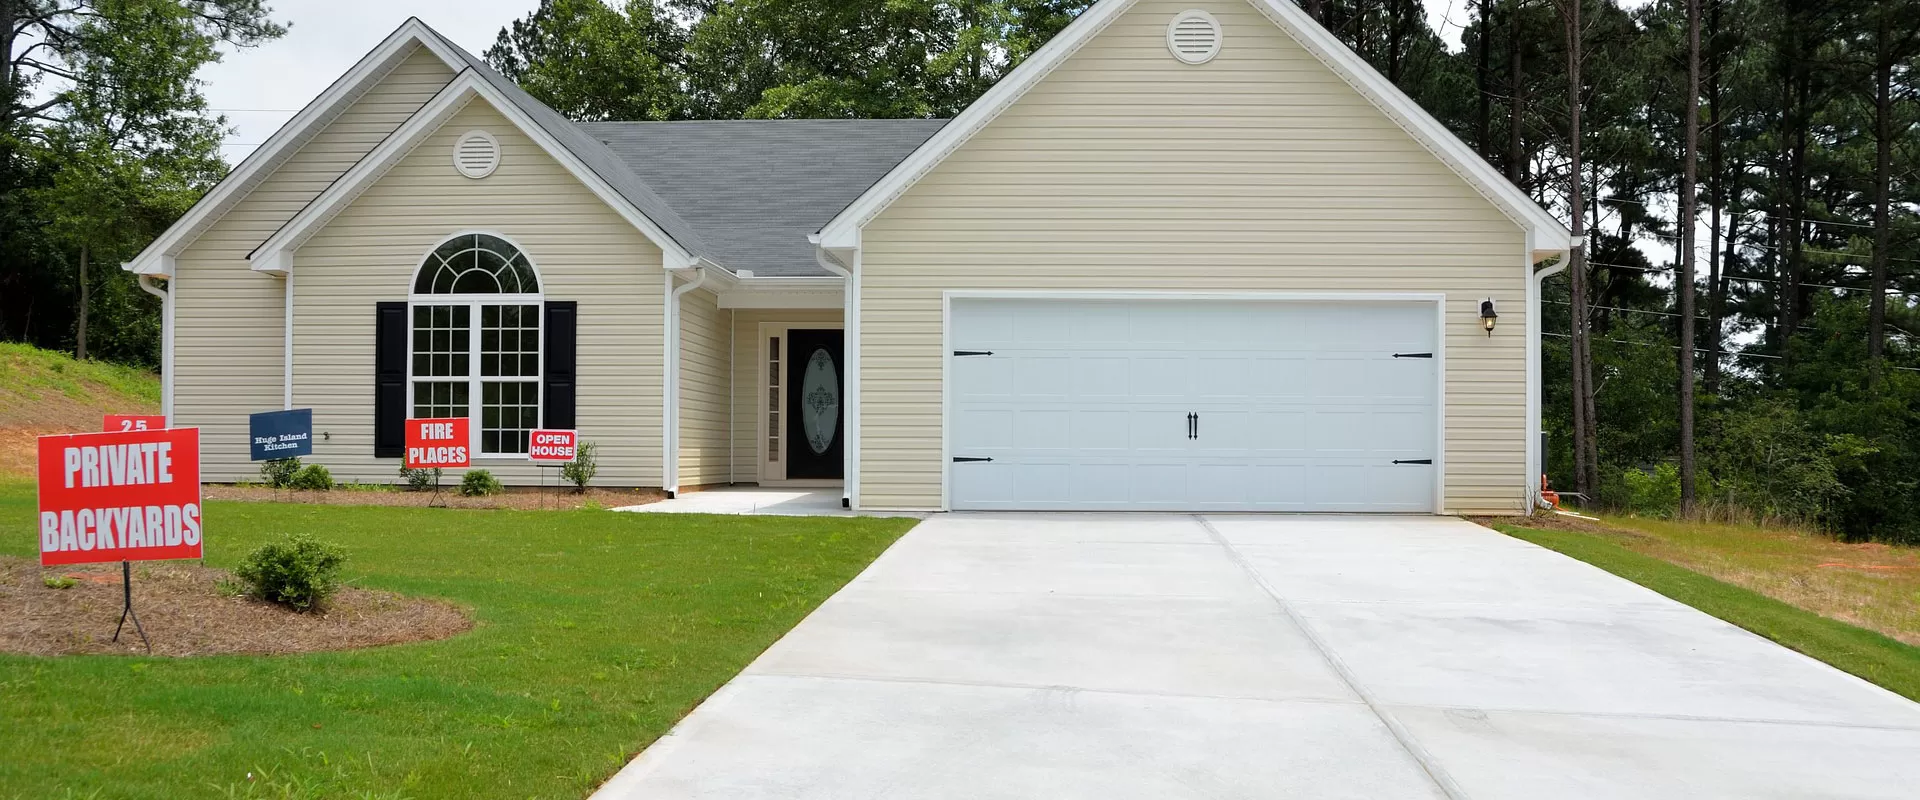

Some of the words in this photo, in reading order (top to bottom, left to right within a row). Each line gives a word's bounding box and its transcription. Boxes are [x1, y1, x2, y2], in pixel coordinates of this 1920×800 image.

[254, 436, 277, 444] Huge
[279, 432, 308, 442] Island
[421, 423, 454, 440] FIRE
[263, 442, 298, 451] Kitchen
[536, 434, 570, 445] OPEN
[409, 446, 467, 464] PLACES
[531, 446, 574, 456] HOUSE
[64, 441, 173, 489] PRIVATE
[40, 502, 200, 552] BACKYARDS
